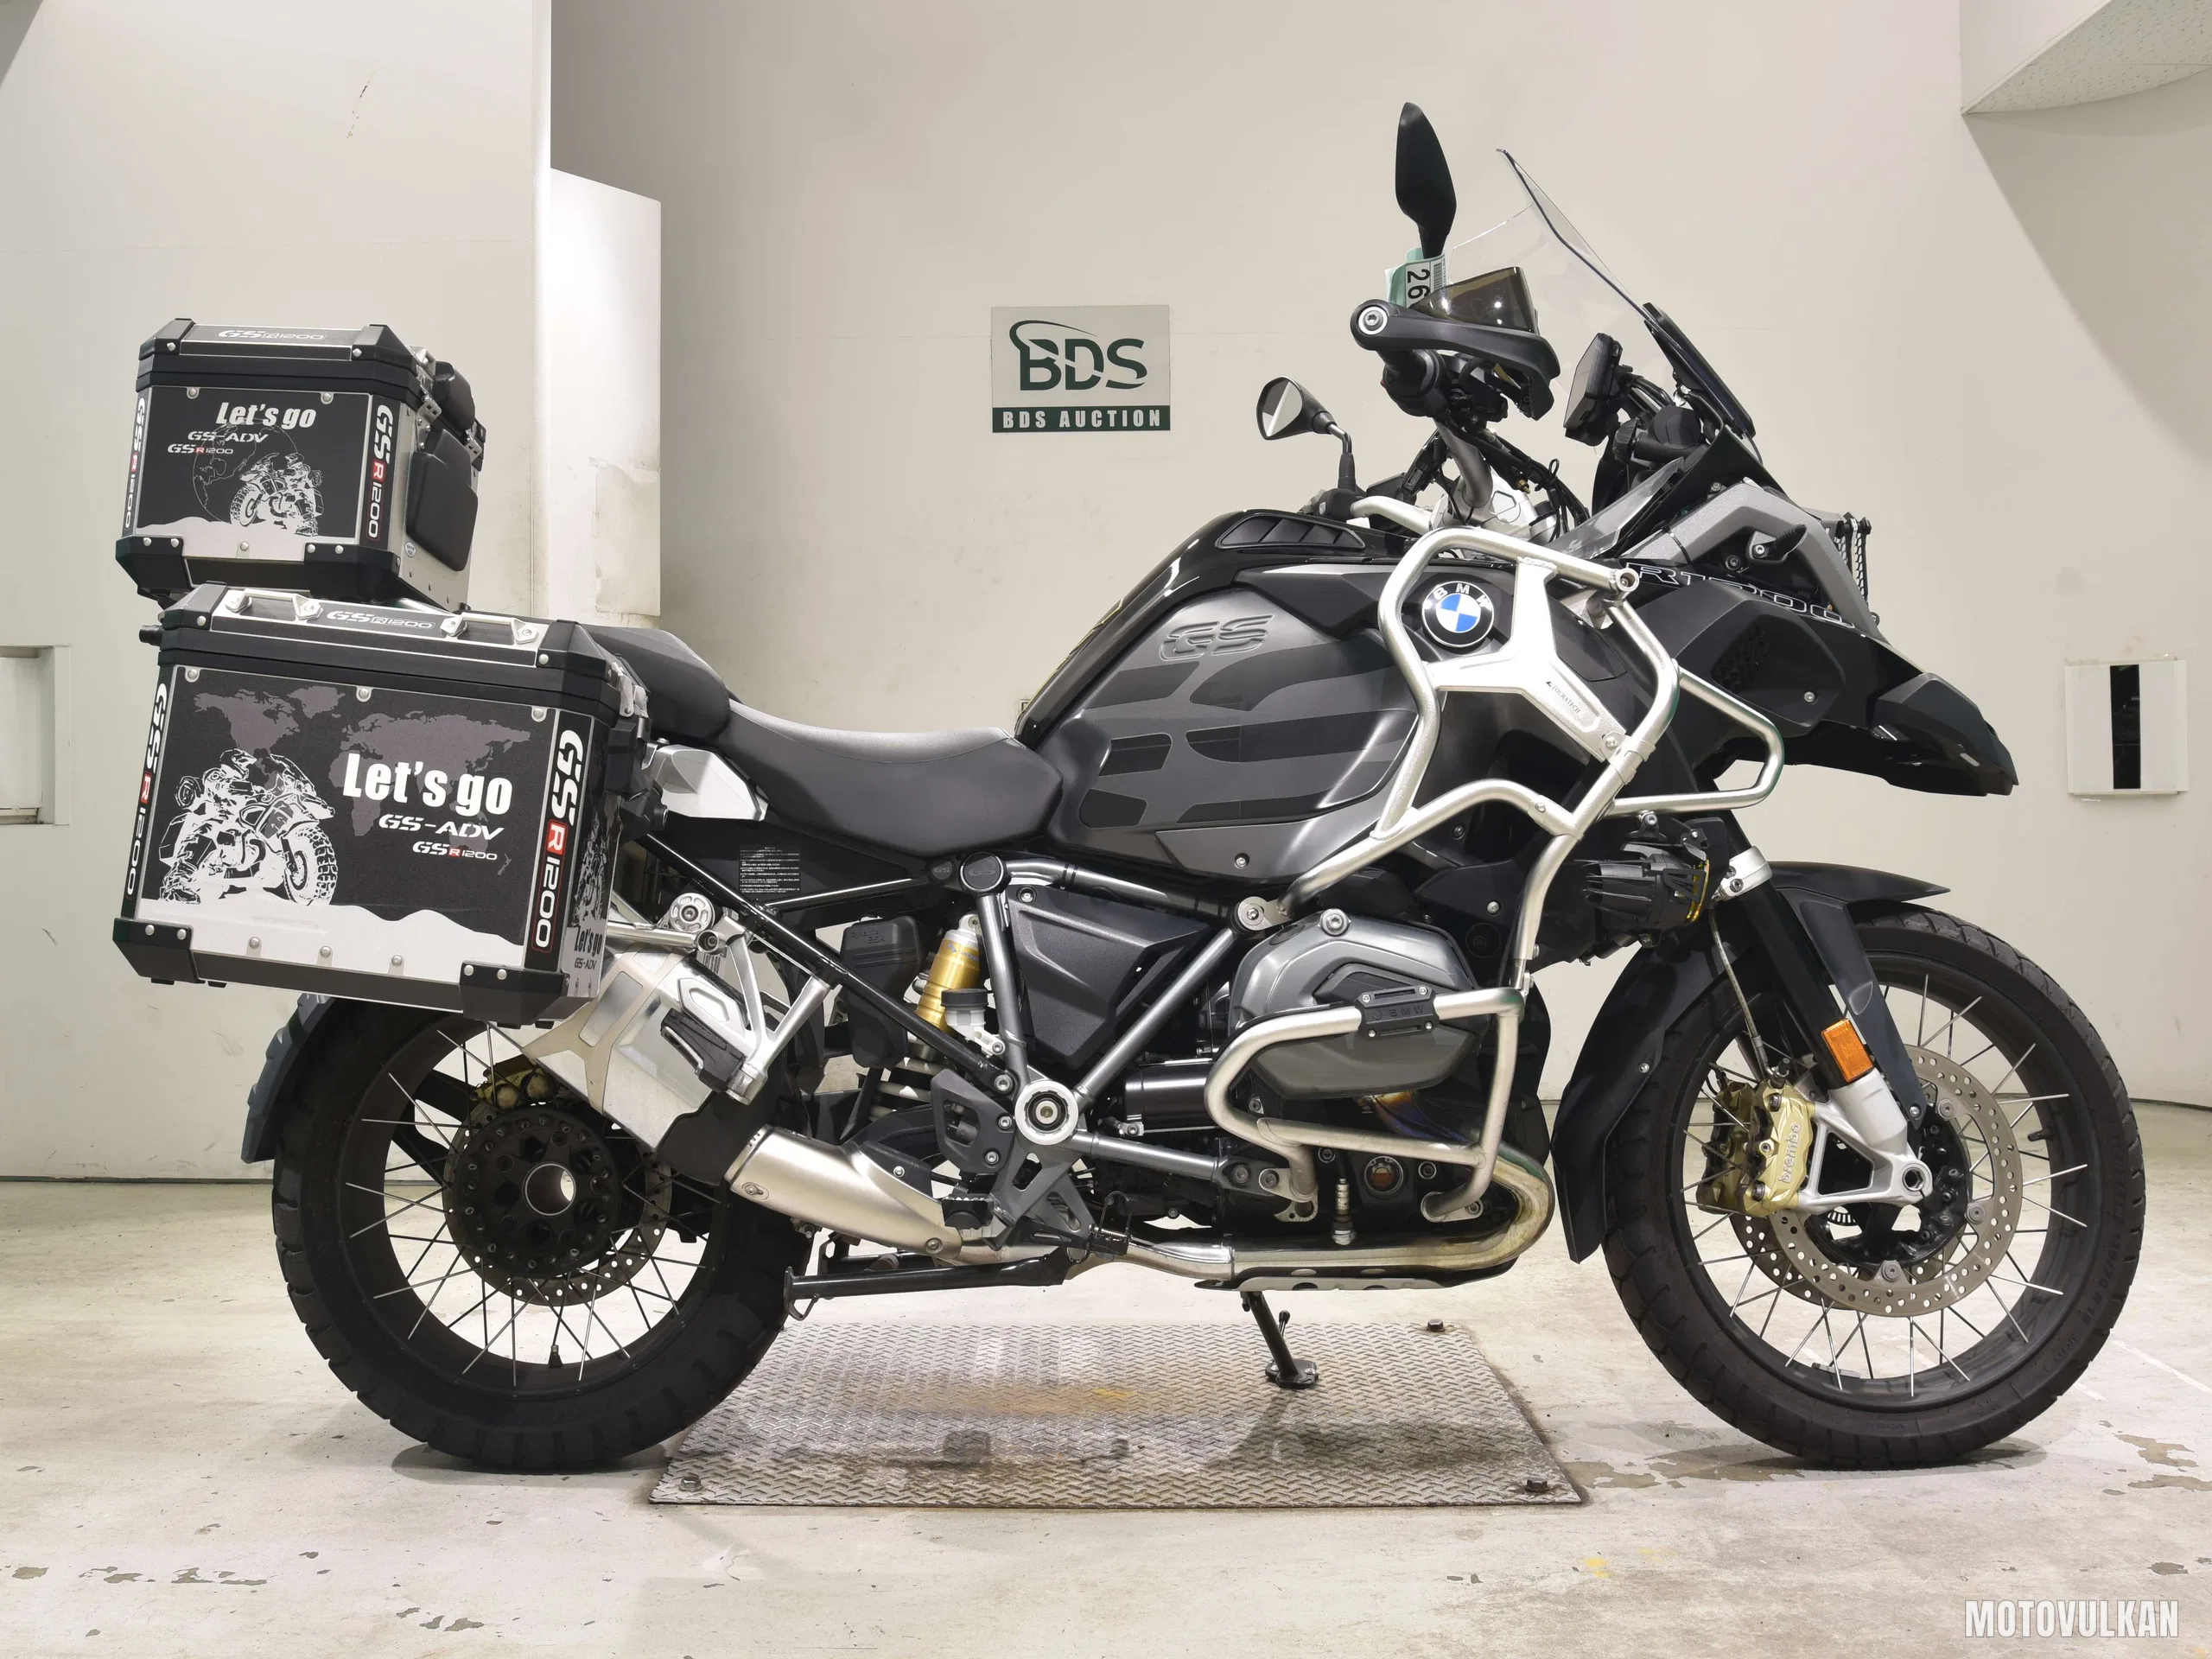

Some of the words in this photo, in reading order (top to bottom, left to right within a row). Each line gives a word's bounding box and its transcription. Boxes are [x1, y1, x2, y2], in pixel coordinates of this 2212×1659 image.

[1009, 320, 1148, 391] BDS
[216, 402, 279, 426] Let's
[281, 408, 316, 430] go
[1002, 410, 1046, 429] BDS
[1059, 410, 1160, 429] AUCTION
[188, 430, 270, 443] GS-ADV
[1433, 583, 1493, 612] BMW
[1159, 614, 1274, 661] GS
[1552, 685, 1581, 714] TOURATECH
[342, 753, 448, 807] Let's
[455, 773, 513, 817] go
[378, 813, 505, 841] GS-ADV
[574, 926, 593, 954] Let's
[592, 934, 603, 957] go
[574, 957, 597, 970] GS-ADV
[1389, 1005, 1424, 1018] BMW
[1778, 1122, 1802, 1184] brembo
